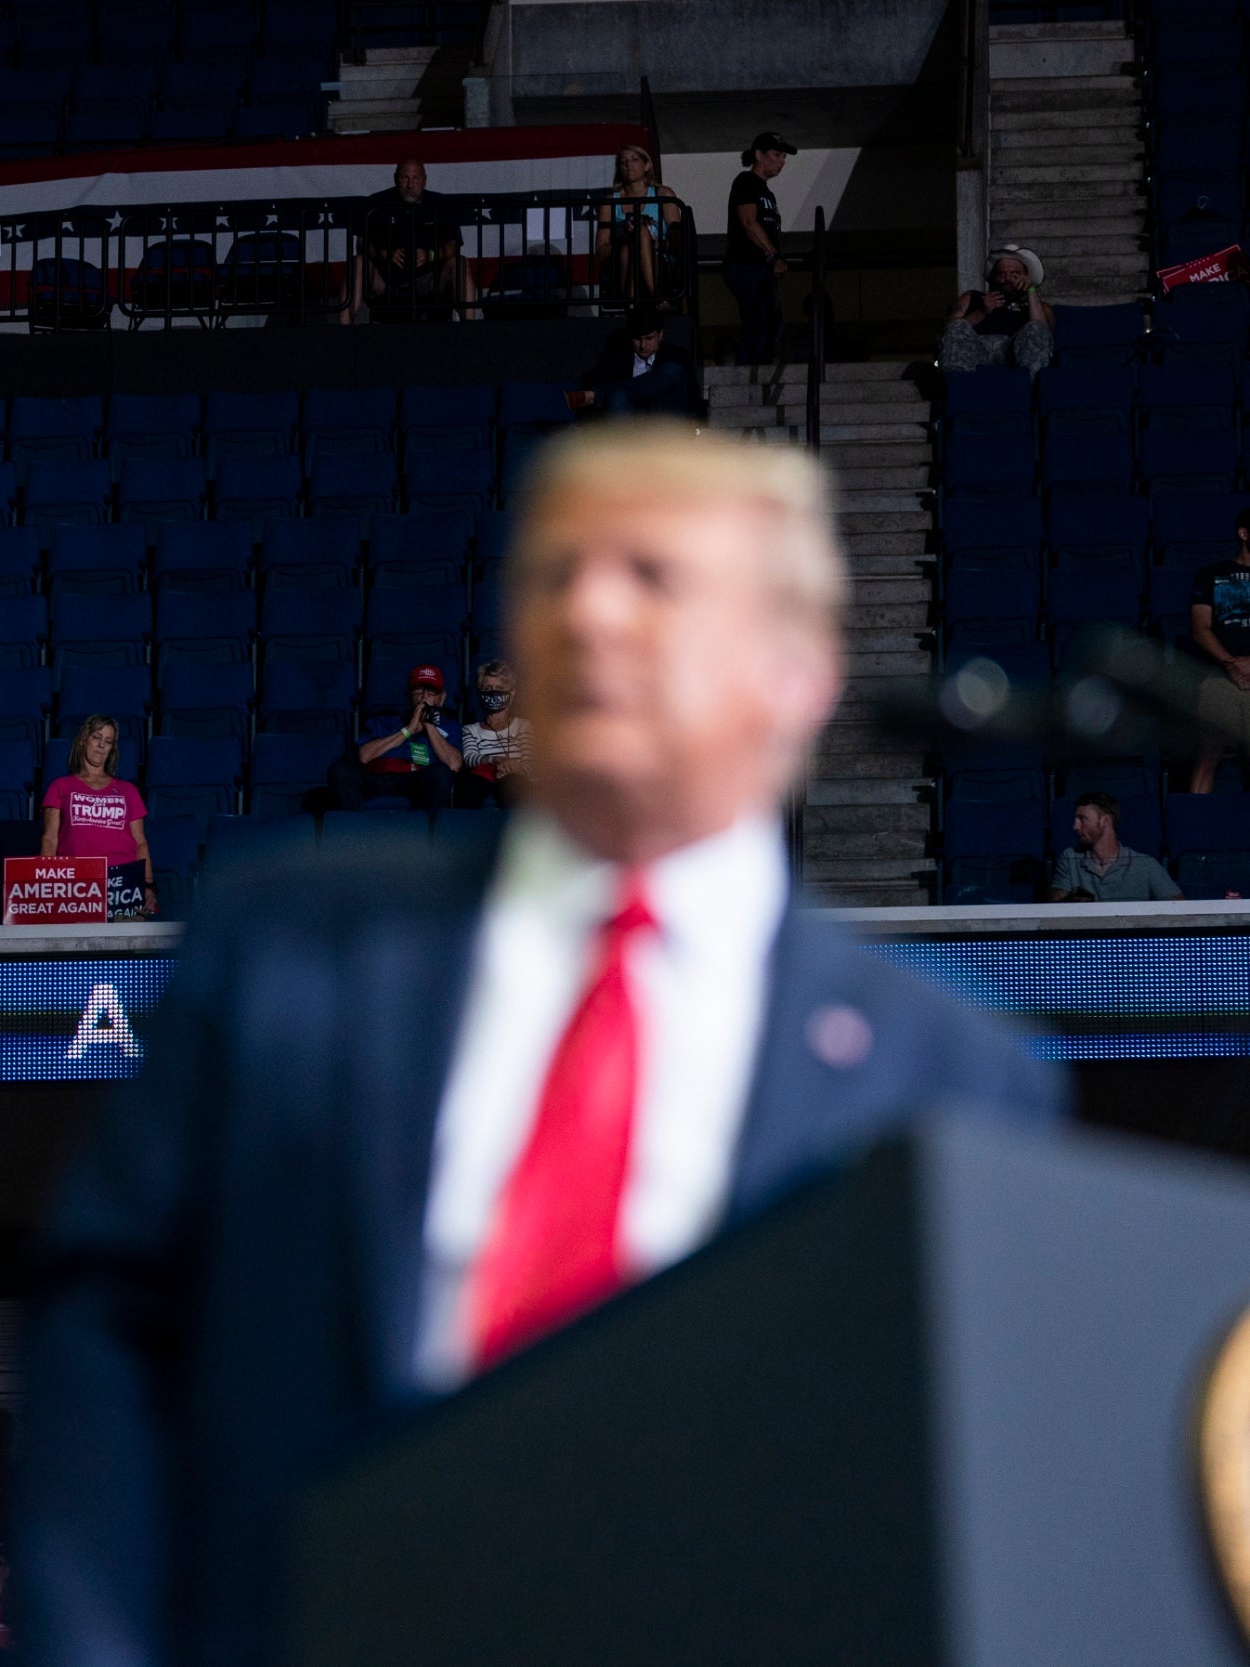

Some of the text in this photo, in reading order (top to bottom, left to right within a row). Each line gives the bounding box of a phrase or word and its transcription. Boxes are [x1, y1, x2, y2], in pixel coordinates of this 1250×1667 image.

[1190, 263, 1222, 283] MAKE
[74, 795, 124, 805] WOMEN
[72, 804, 125, 819] TRUMP
[35, 867, 76, 880] MAKE
[107, 876, 124, 888] KE
[10, 881, 103, 899] AMERICA
[107, 886, 143, 905] RICA
[10, 902, 103, 914] GREAT AGAIN
